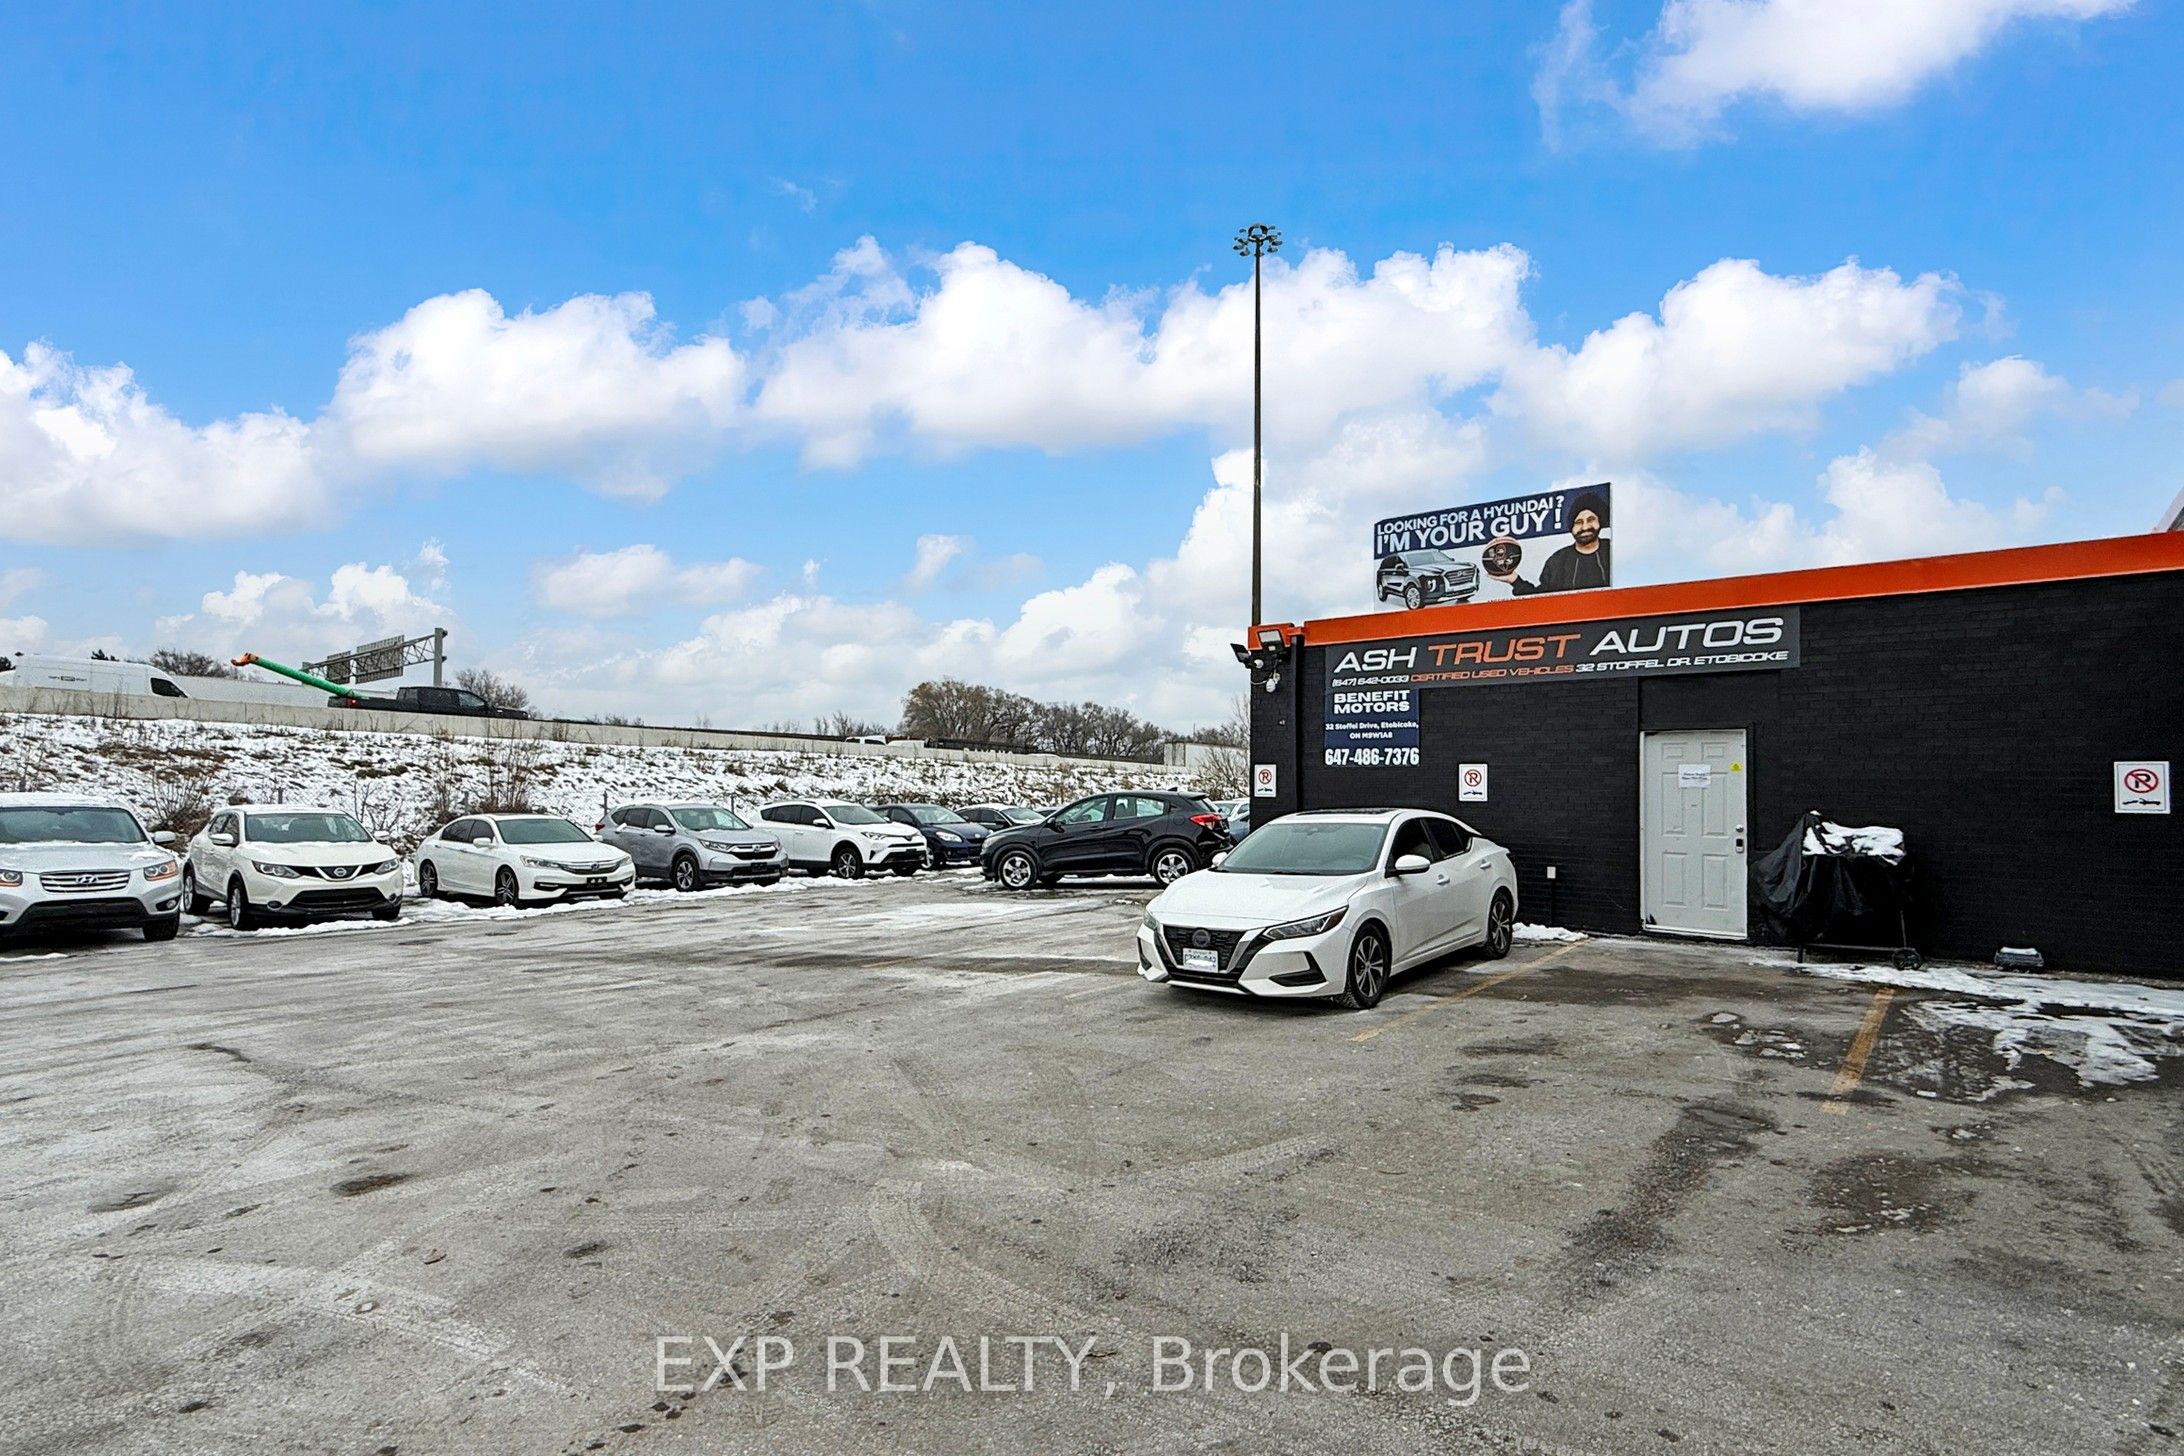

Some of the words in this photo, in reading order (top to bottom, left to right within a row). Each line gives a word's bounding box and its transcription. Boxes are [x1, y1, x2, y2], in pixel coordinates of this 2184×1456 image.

[1377, 516, 1438, 535] LOOKING
[1440, 511, 1468, 526] FOR
[1470, 508, 1482, 521] A
[1483, 496, 1553, 520] HYUNDAI
[1377, 531, 1410, 554] I'M
[1415, 520, 1486, 548] YOUR
[1490, 510, 1549, 538] GUY
[1333, 646, 1418, 674] ASH
[1428, 633, 1582, 667] TRUST
[1589, 617, 1784, 656] AUTOS
[1410, 671, 1470, 682] CERTIFIED
[1471, 668, 1507, 679] USED
[1509, 664, 1574, 677] VEHICLES
[1575, 663, 1596, 673] 32
[1596, 658, 1665, 672] STOFFEL
[1693, 650, 1790, 666] ETOBICOKE
[1334, 690, 1410, 704] BENEFIT
[1334, 701, 1410, 714] MOTORS
[1325, 747, 1420, 766] 647-486-7376
